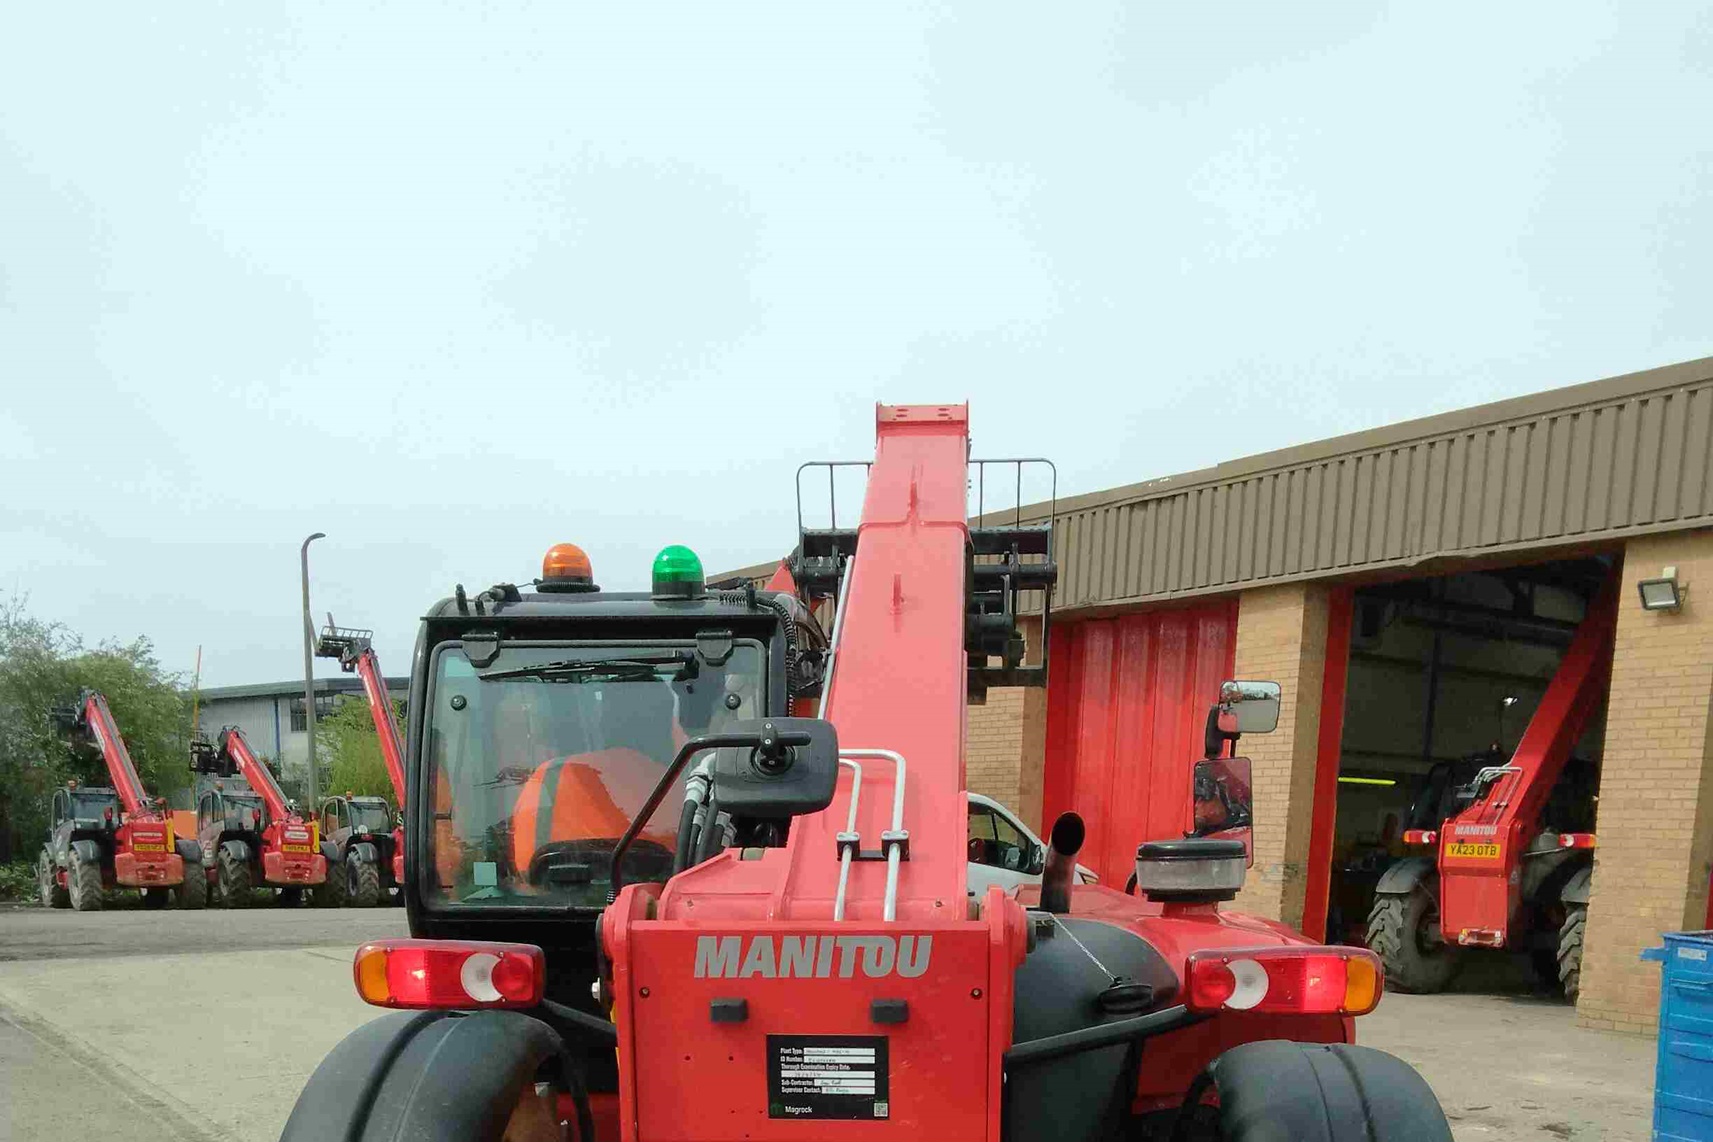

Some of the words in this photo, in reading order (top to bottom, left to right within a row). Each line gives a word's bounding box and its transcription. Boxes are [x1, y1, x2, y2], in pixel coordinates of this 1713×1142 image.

[1455, 825, 1497, 835] MANITOU
[1450, 845, 1475, 855] YA23
[694, 935, 933, 978] MANITOU
[785, 1105, 813, 1115] Magrock
